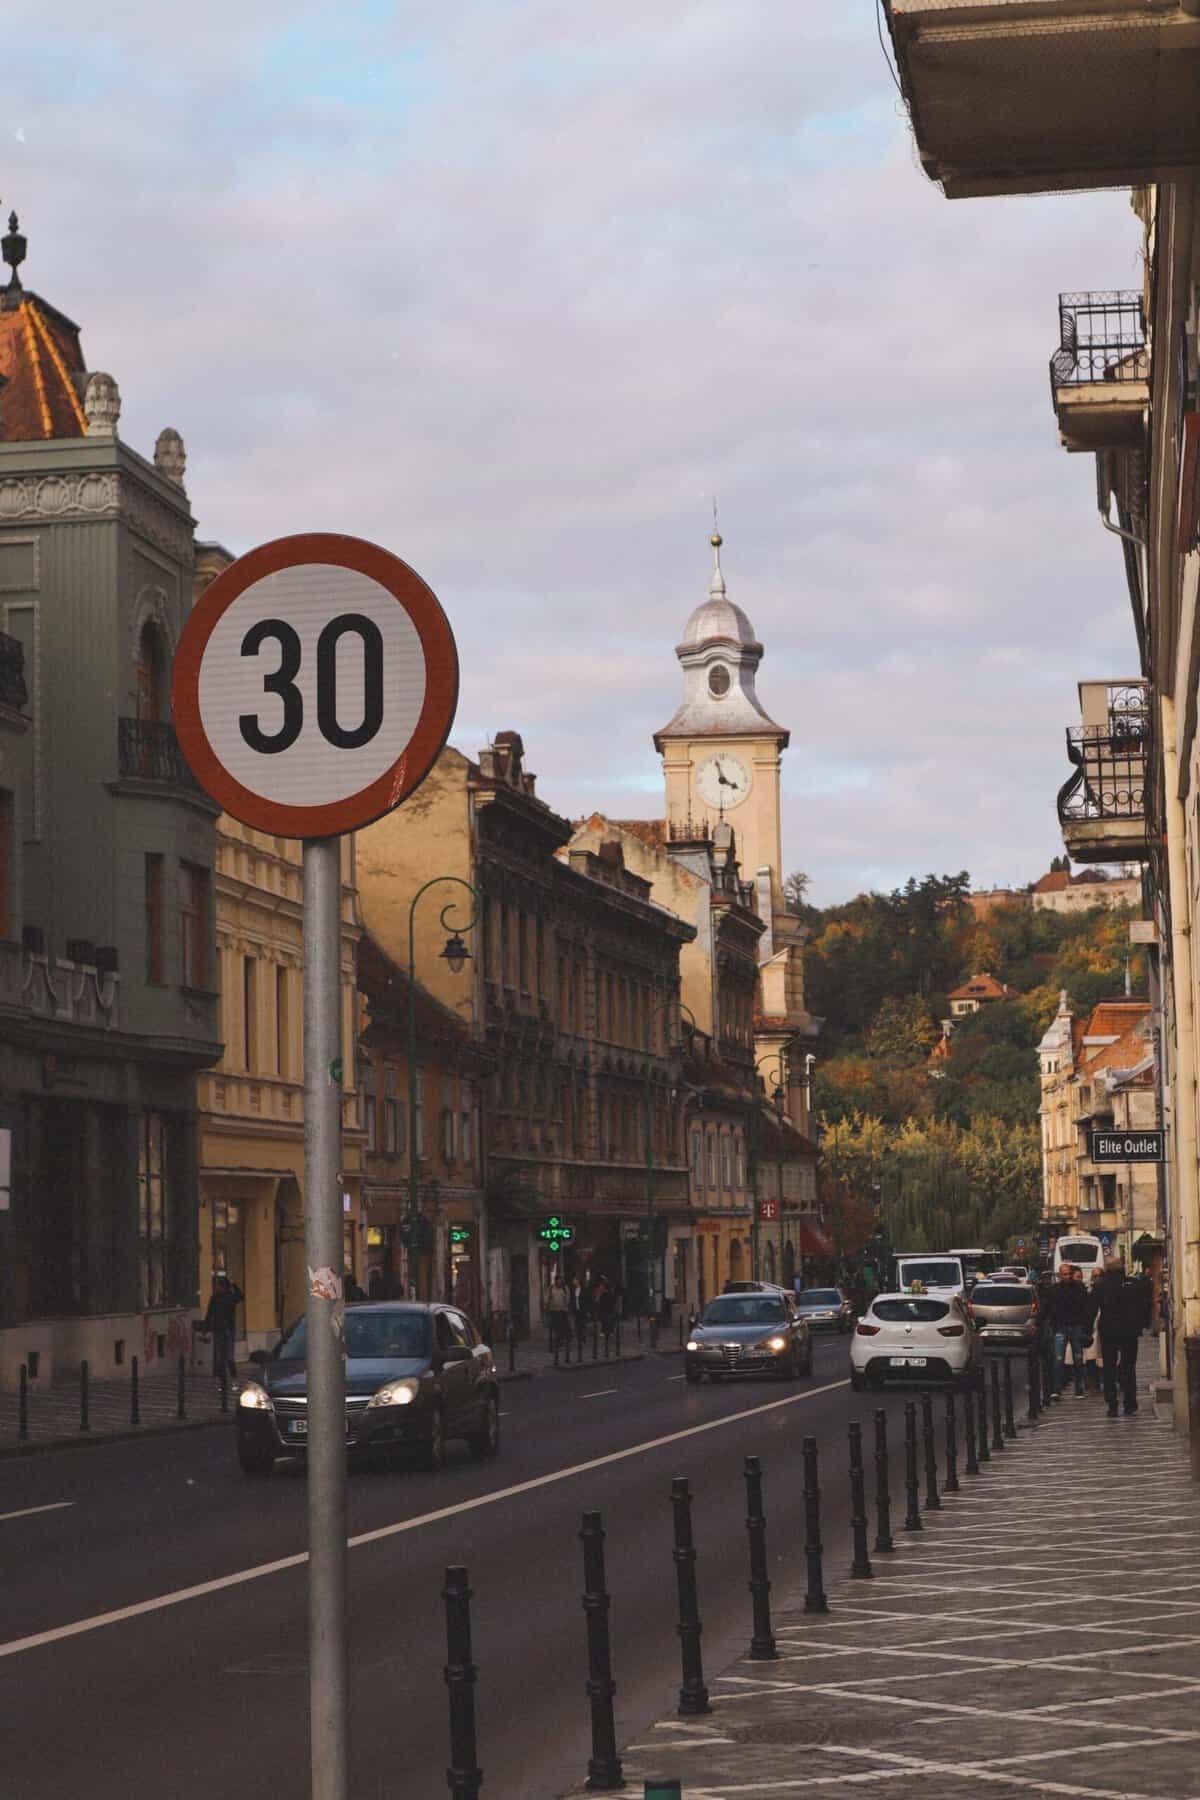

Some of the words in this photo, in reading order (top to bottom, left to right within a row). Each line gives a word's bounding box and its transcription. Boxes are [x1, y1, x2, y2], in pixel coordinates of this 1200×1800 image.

[239, 613, 383, 754] 30
[1099, 1139, 1121, 1153] Elite
[1125, 1139, 1157, 1153] Outlet
